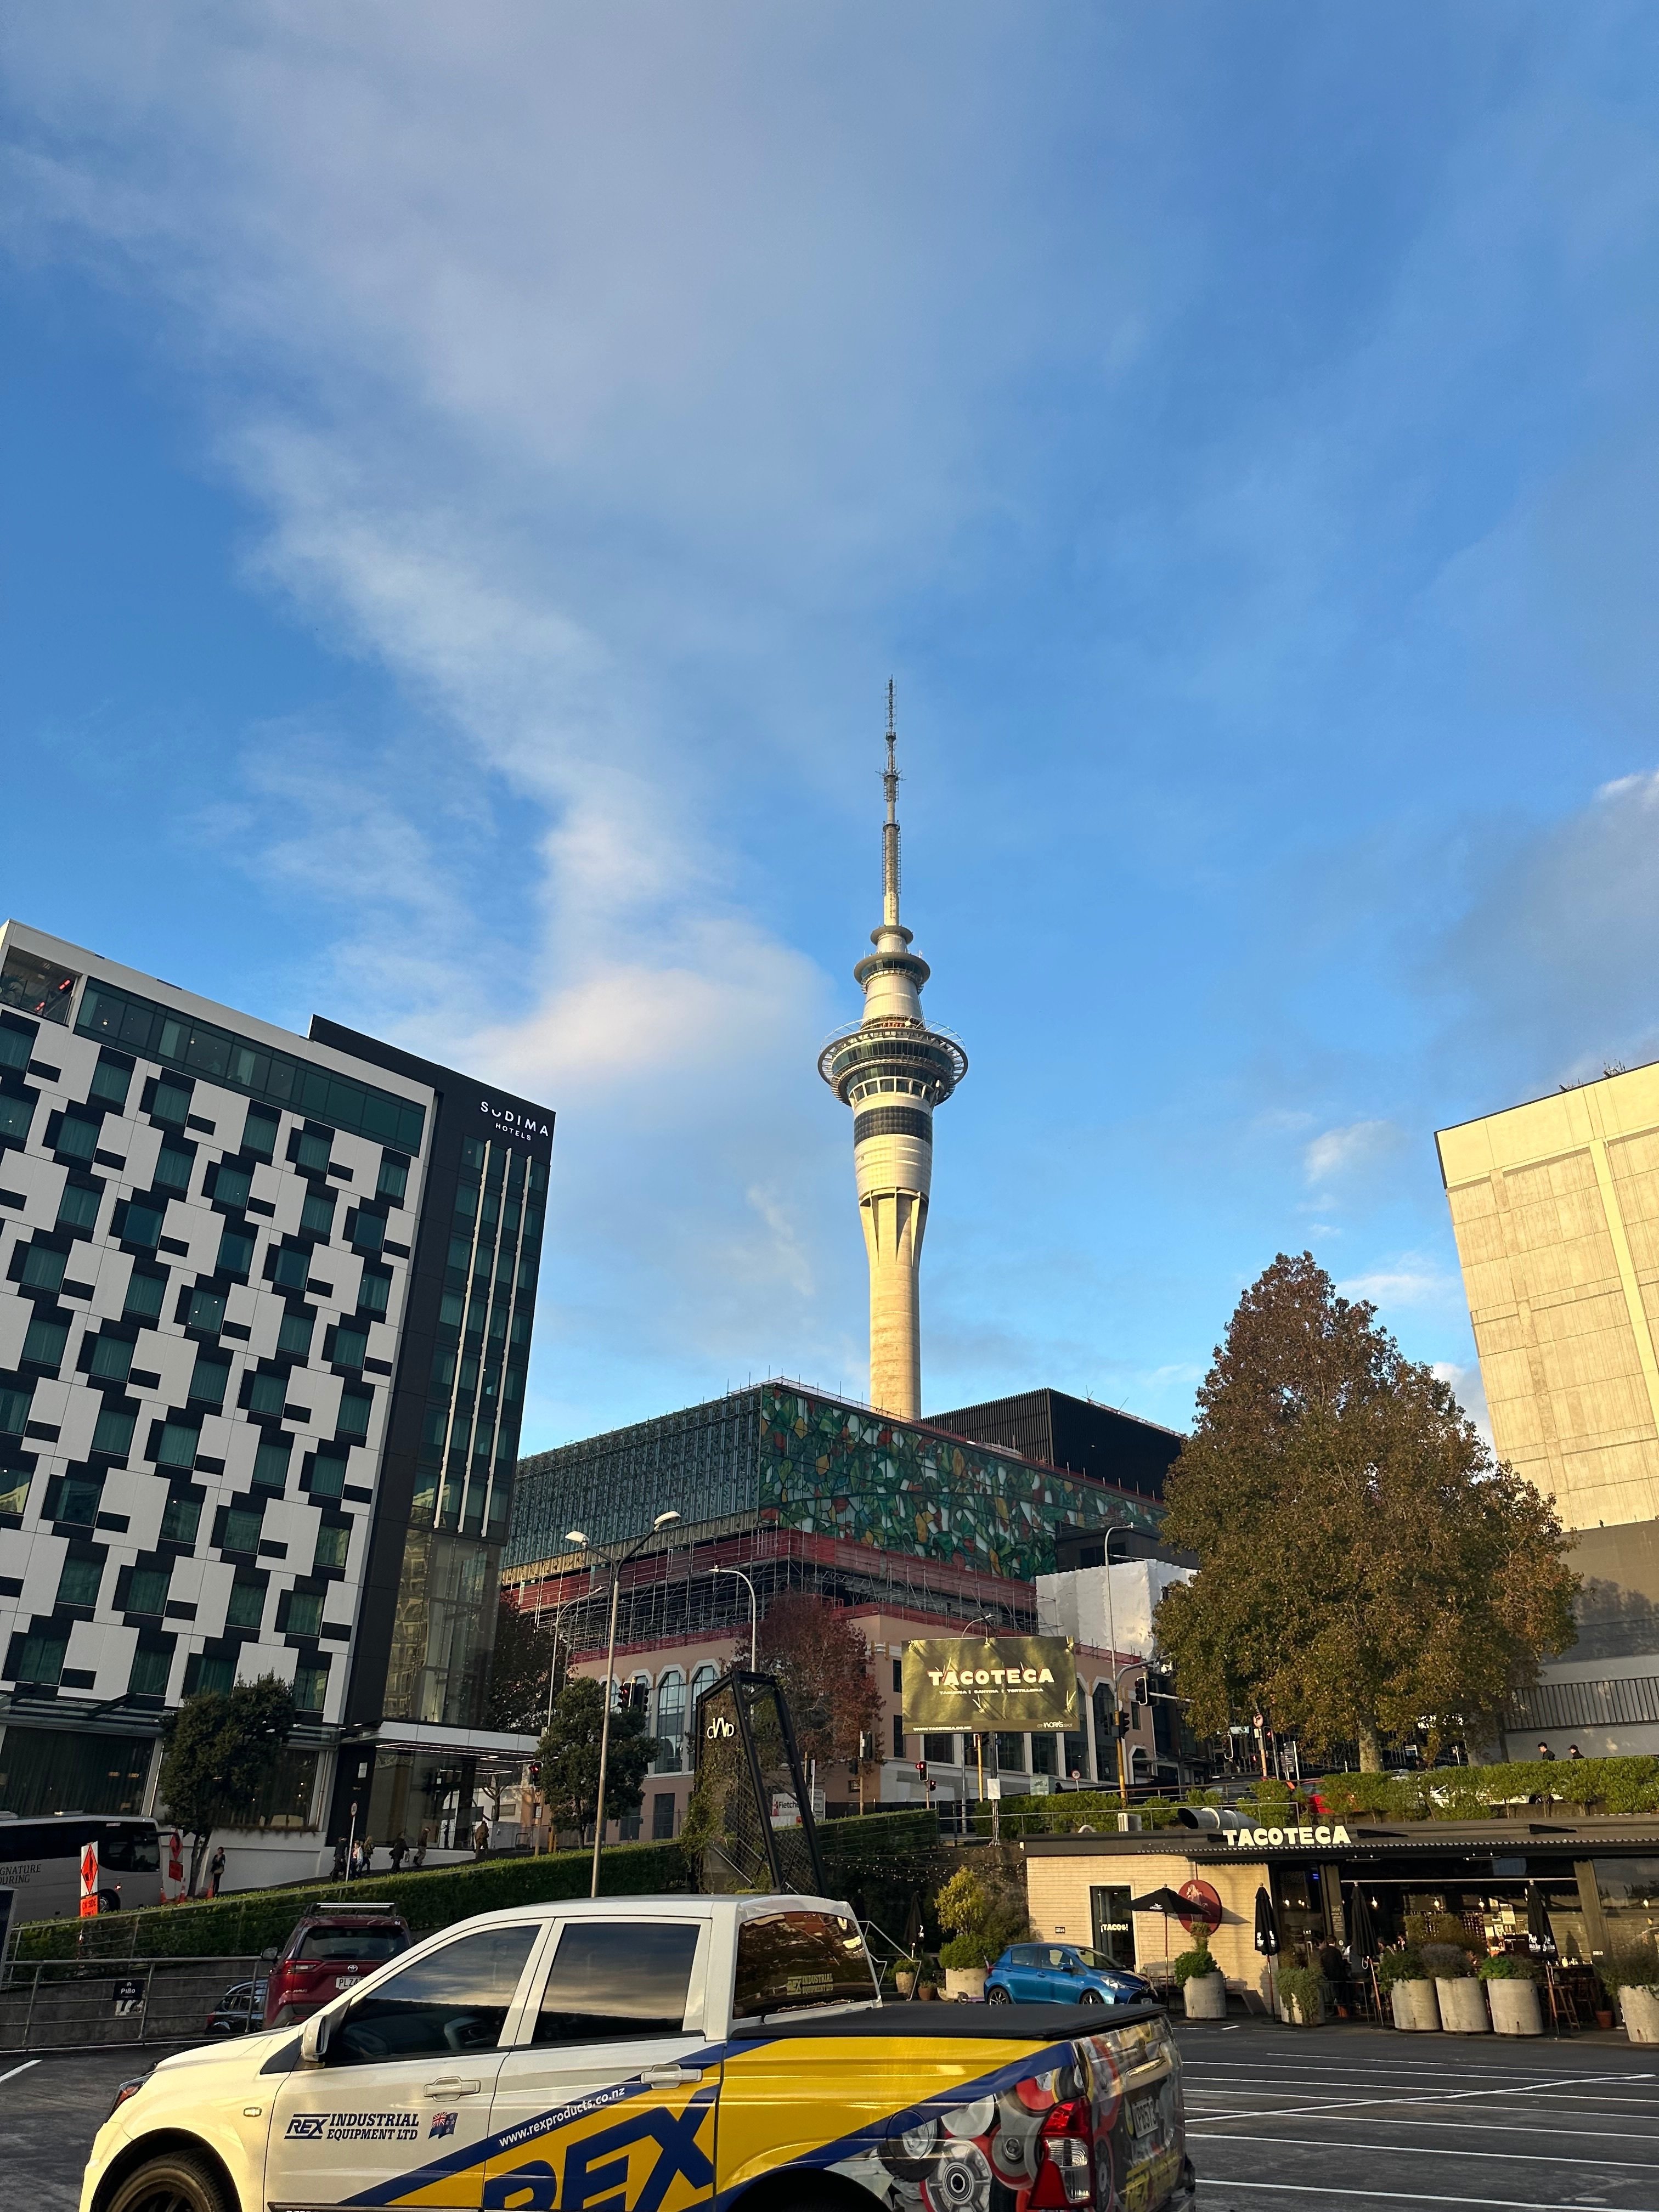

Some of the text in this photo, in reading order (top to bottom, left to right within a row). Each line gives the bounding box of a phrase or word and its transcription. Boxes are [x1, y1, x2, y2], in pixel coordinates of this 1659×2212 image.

[495, 1122, 531, 1141] HOTELS
[927, 1668, 1054, 1686] TACOTECA
[1222, 1825, 1351, 1847] TACOTECA
[802, 1973, 833, 1985] INDUSTRIAL
[329, 2113, 419, 2127] INDUSTRIAL
[499, 2087, 625, 2147] www.rexproducts.co.nz
[286, 2118, 328, 2137] REX
[326, 2129, 418, 2141] EQUIPMENT LTD
